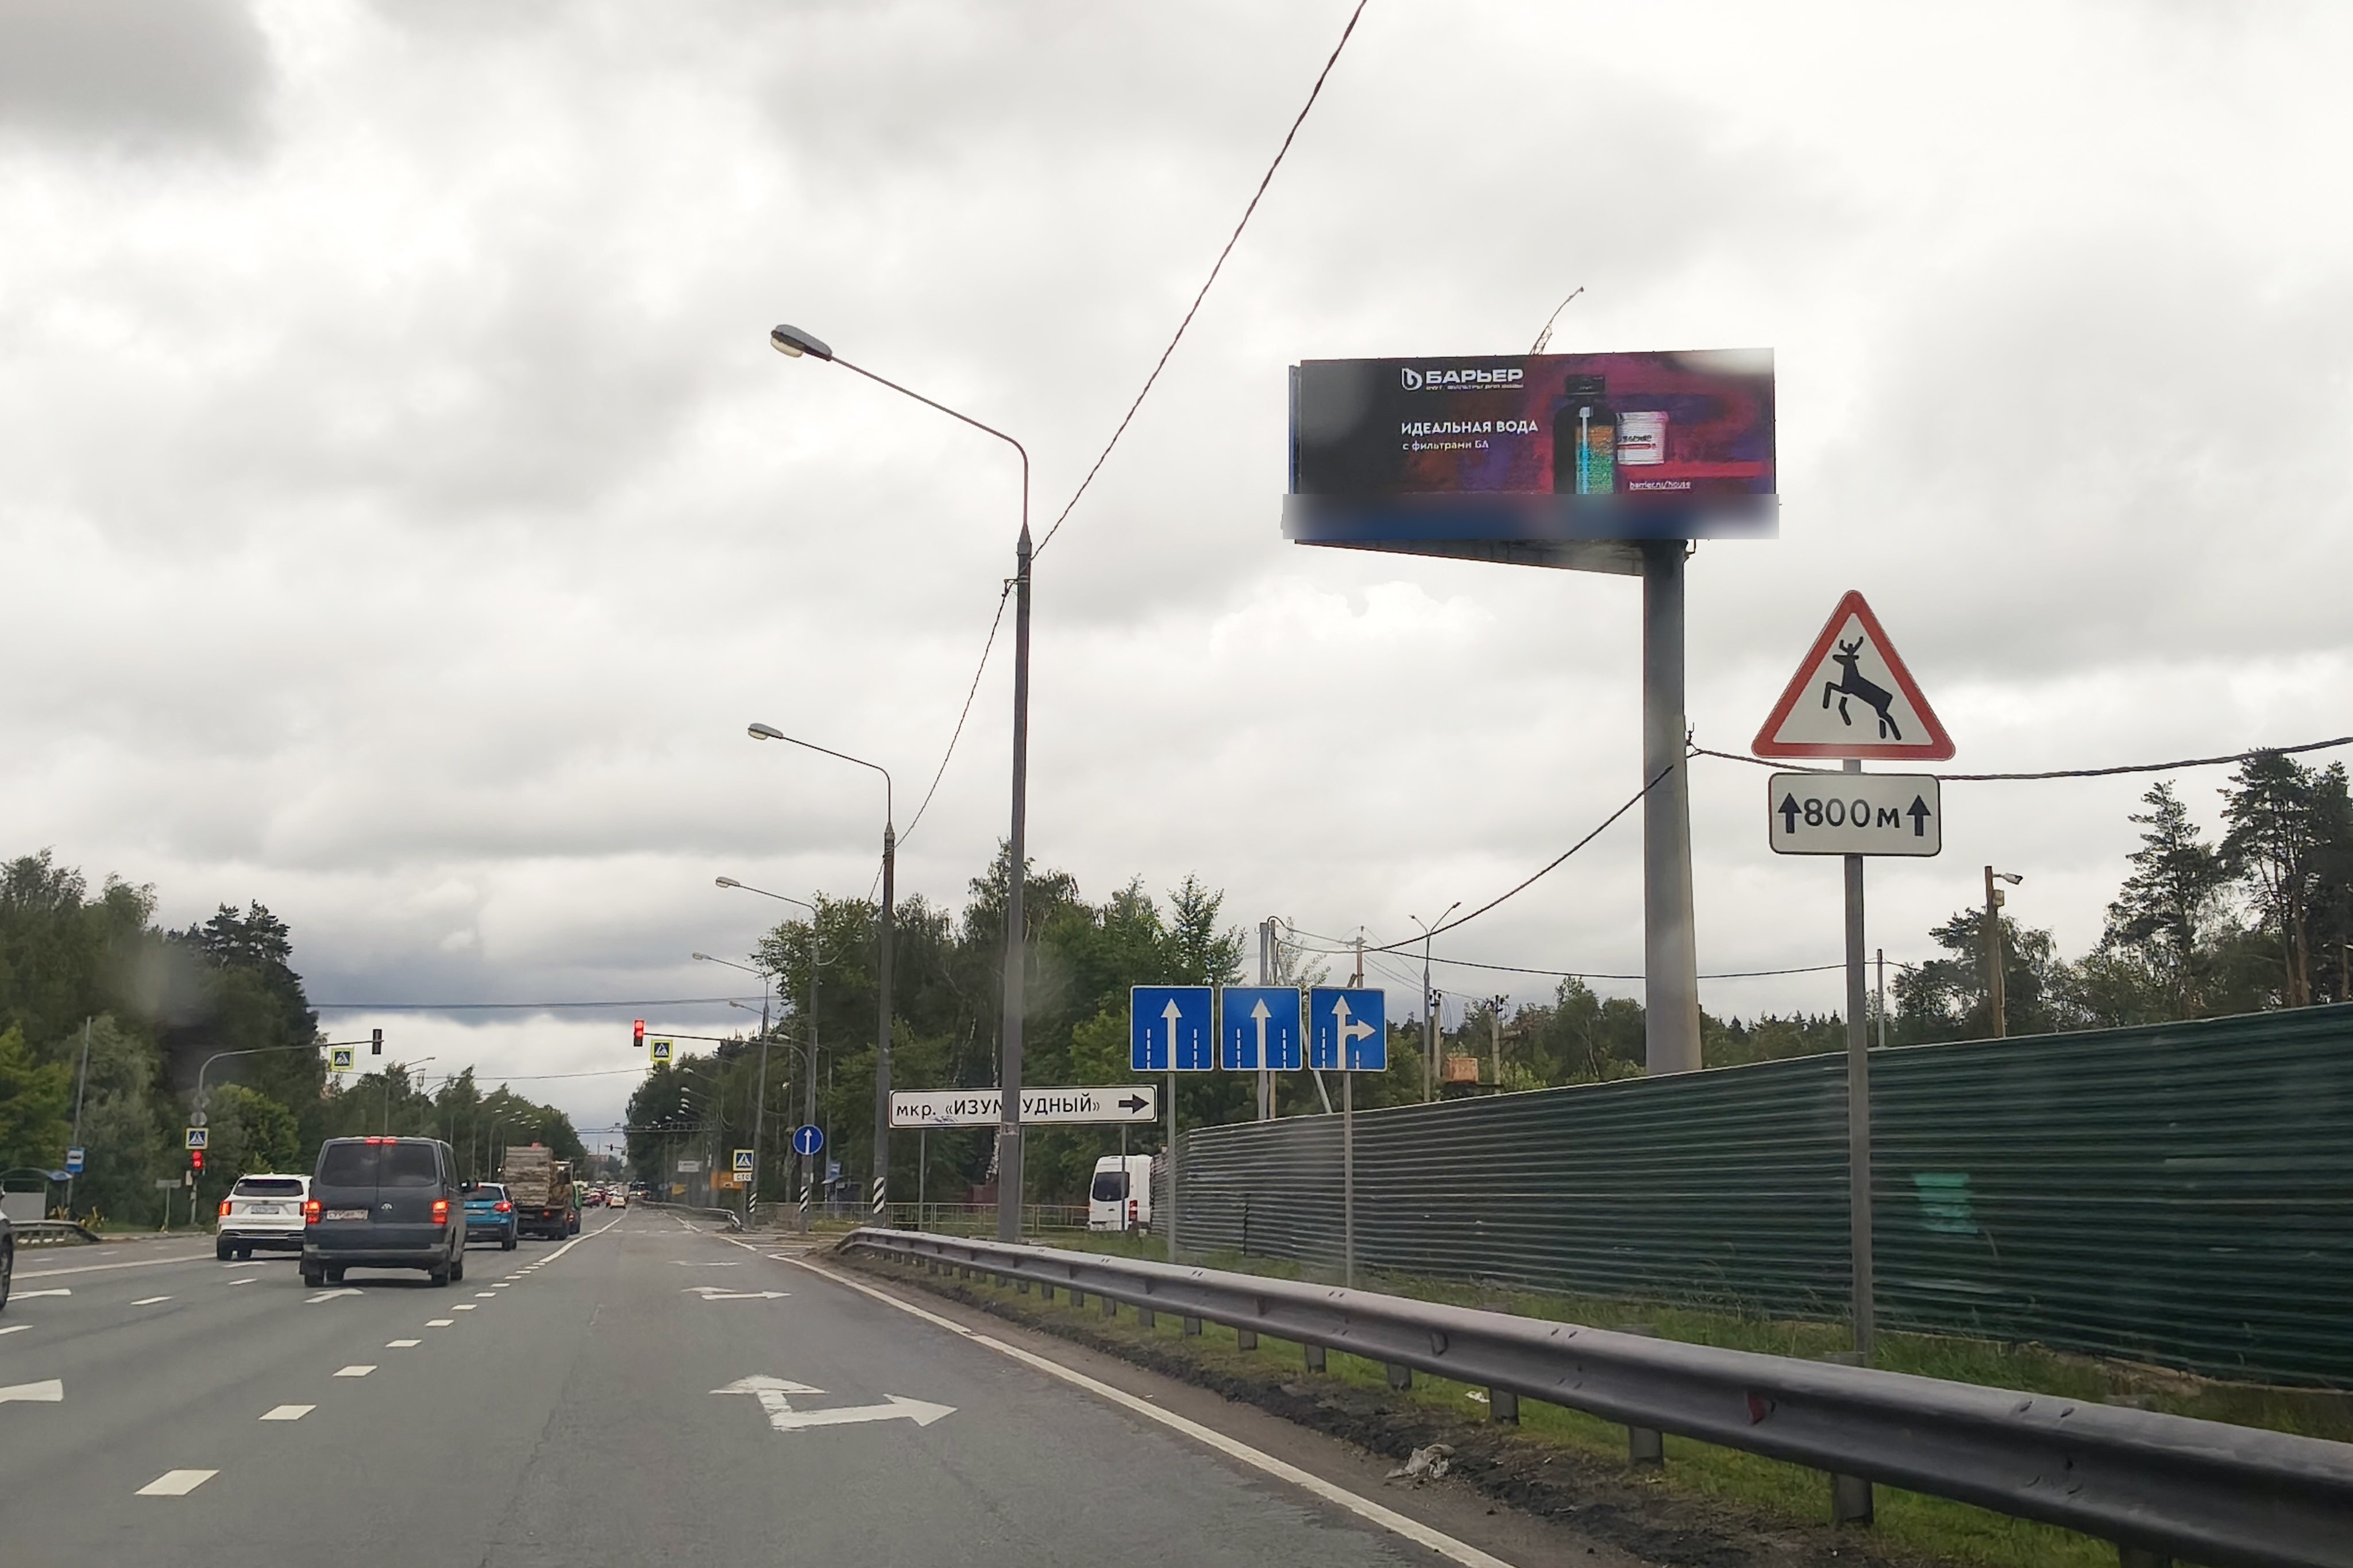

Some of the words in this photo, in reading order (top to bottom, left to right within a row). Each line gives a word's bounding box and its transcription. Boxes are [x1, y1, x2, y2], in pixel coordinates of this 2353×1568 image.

[1426, 369, 1523, 384] БАРЬЕР
[1401, 421, 1491, 437] ИДЕАЛЬНАЯ
[1496, 420, 1538, 434] ВОДА
[1411, 441, 1472, 451] фильтрами
[897, 1104, 936, 1119] мкр.
[945, 1092, 1100, 1115] «ИЗУМУДНЫЙ»
